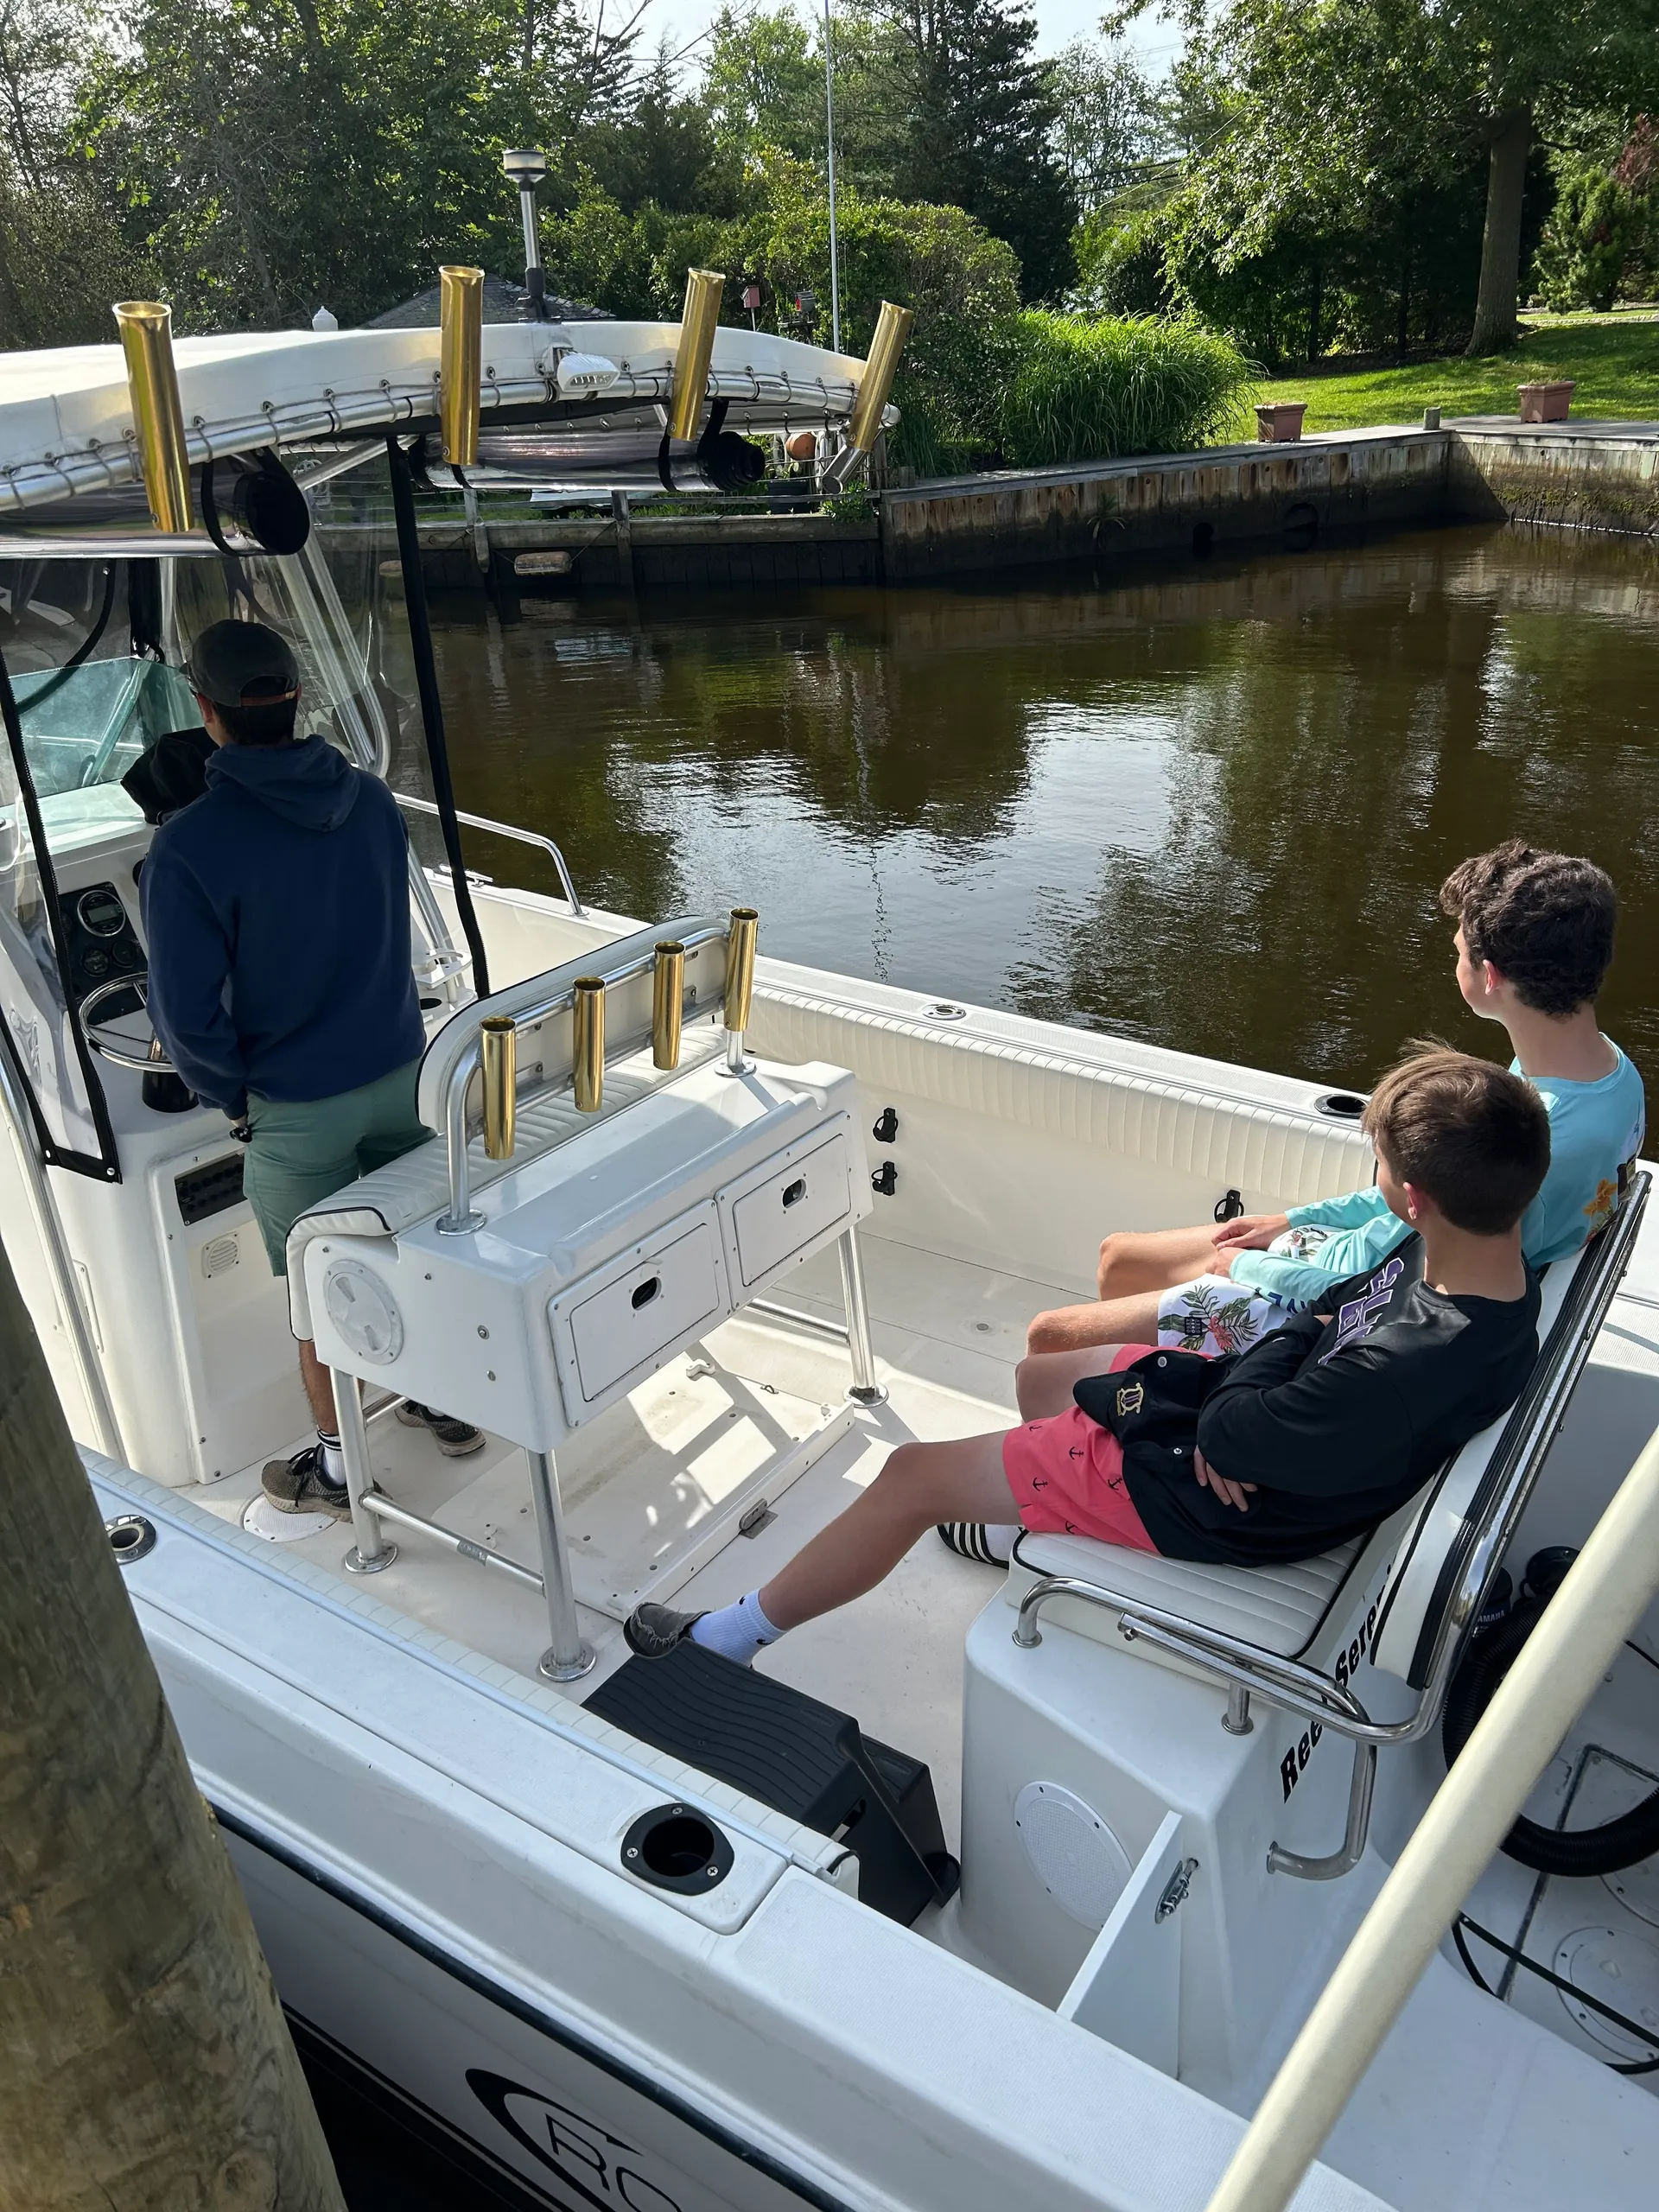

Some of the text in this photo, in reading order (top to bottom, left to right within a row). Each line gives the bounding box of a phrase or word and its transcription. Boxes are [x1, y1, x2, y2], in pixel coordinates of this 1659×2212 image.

[1478, 1610, 1505, 1623] AMAHA
[1281, 1574, 1389, 1804] Ree Sere
